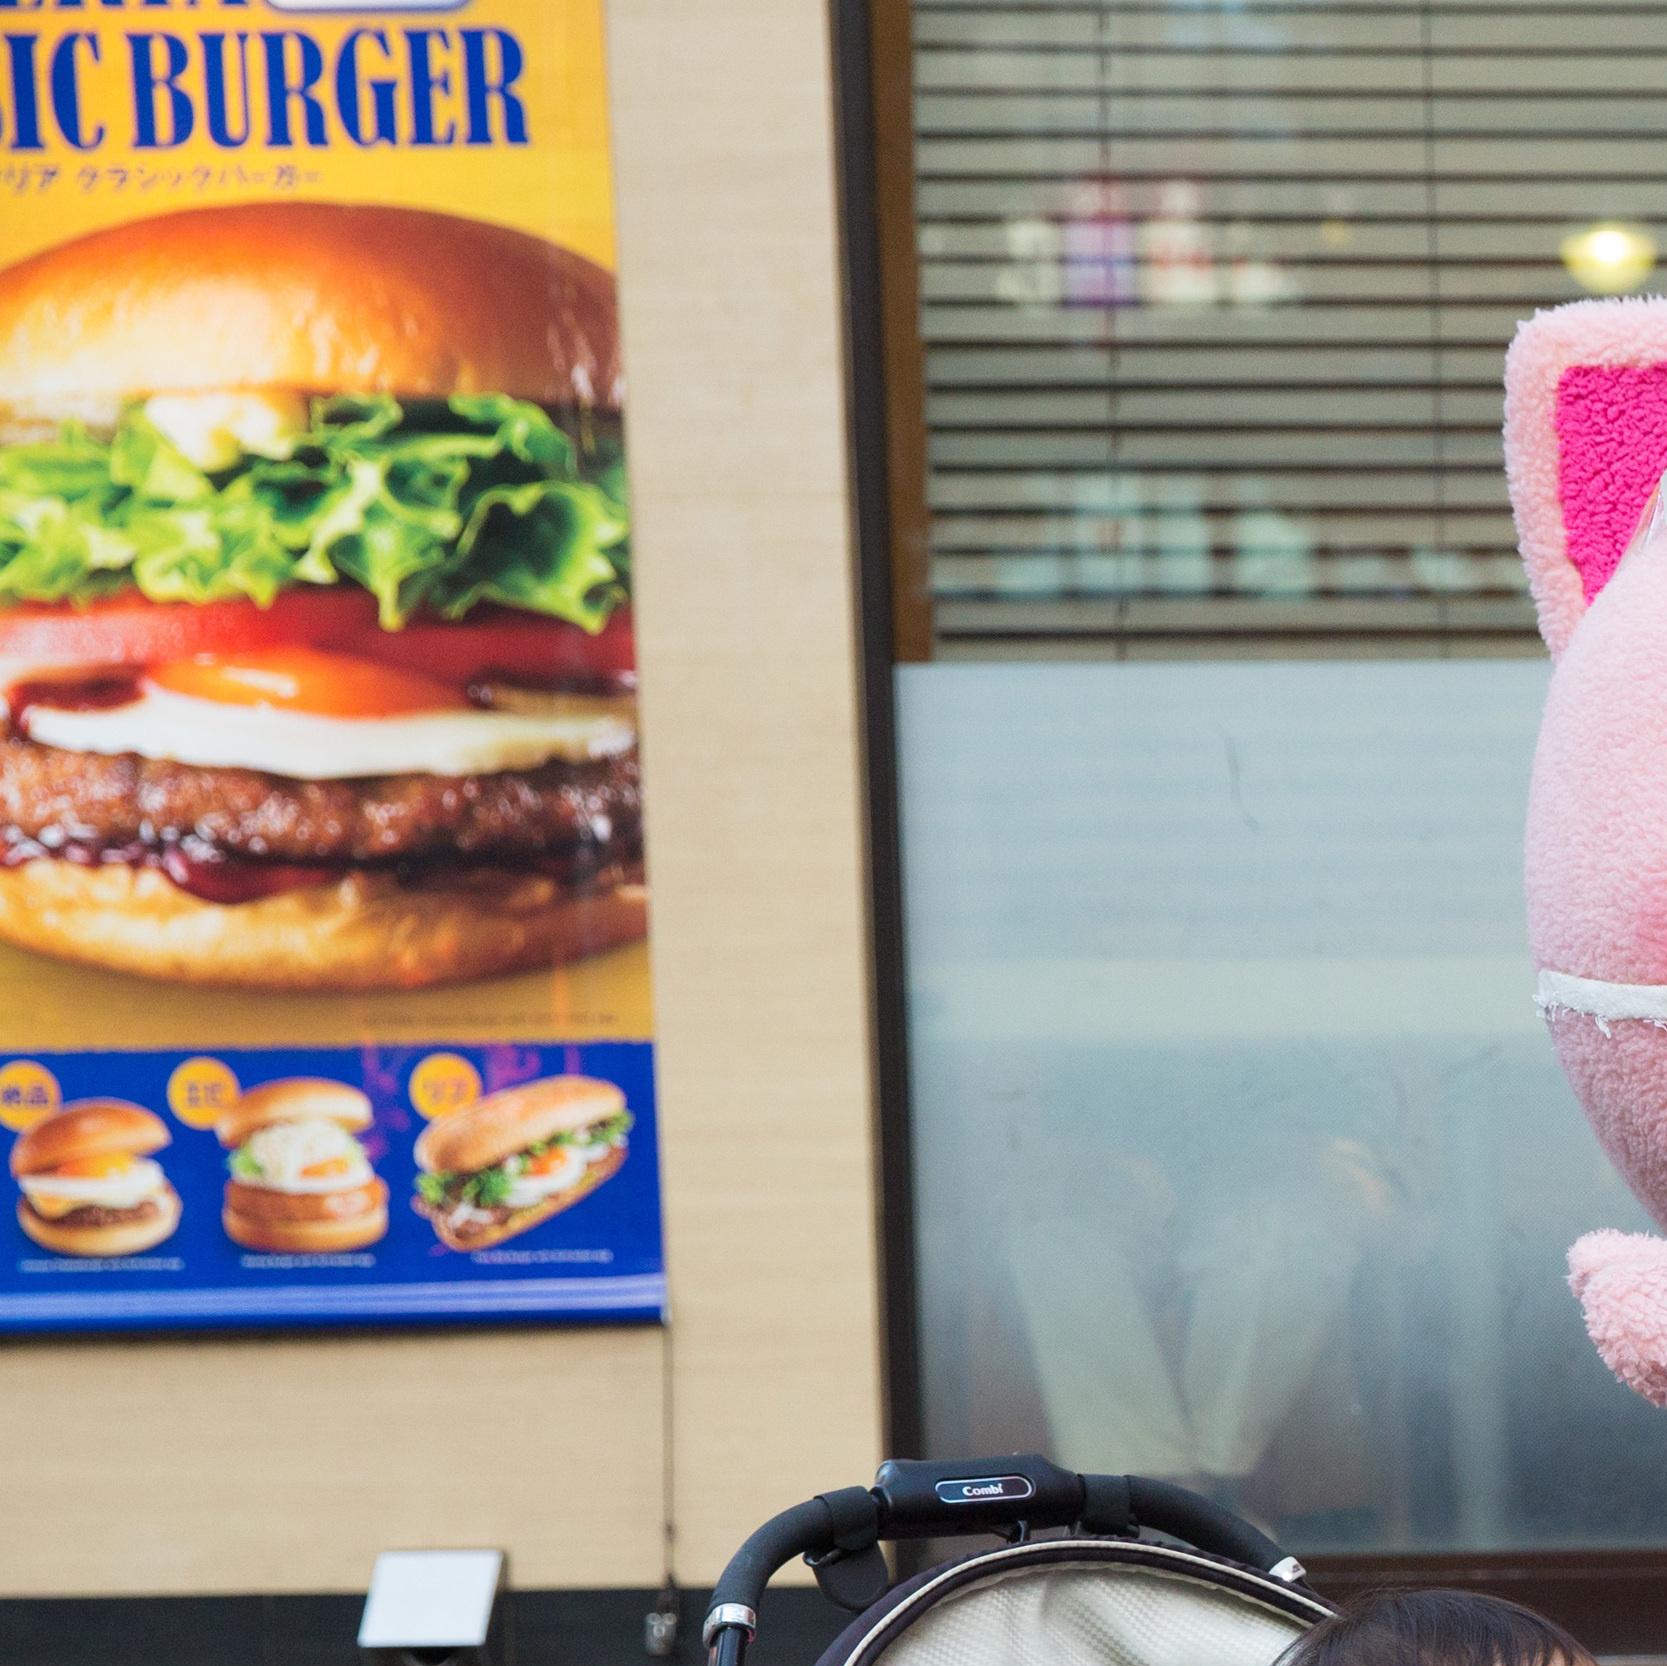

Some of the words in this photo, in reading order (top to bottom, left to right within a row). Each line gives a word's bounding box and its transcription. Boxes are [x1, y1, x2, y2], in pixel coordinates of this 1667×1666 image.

[0, 32, 105, 149] IC
[126, 30, 529, 149] BURGER
[962, 1483, 1004, 1497] Combi
